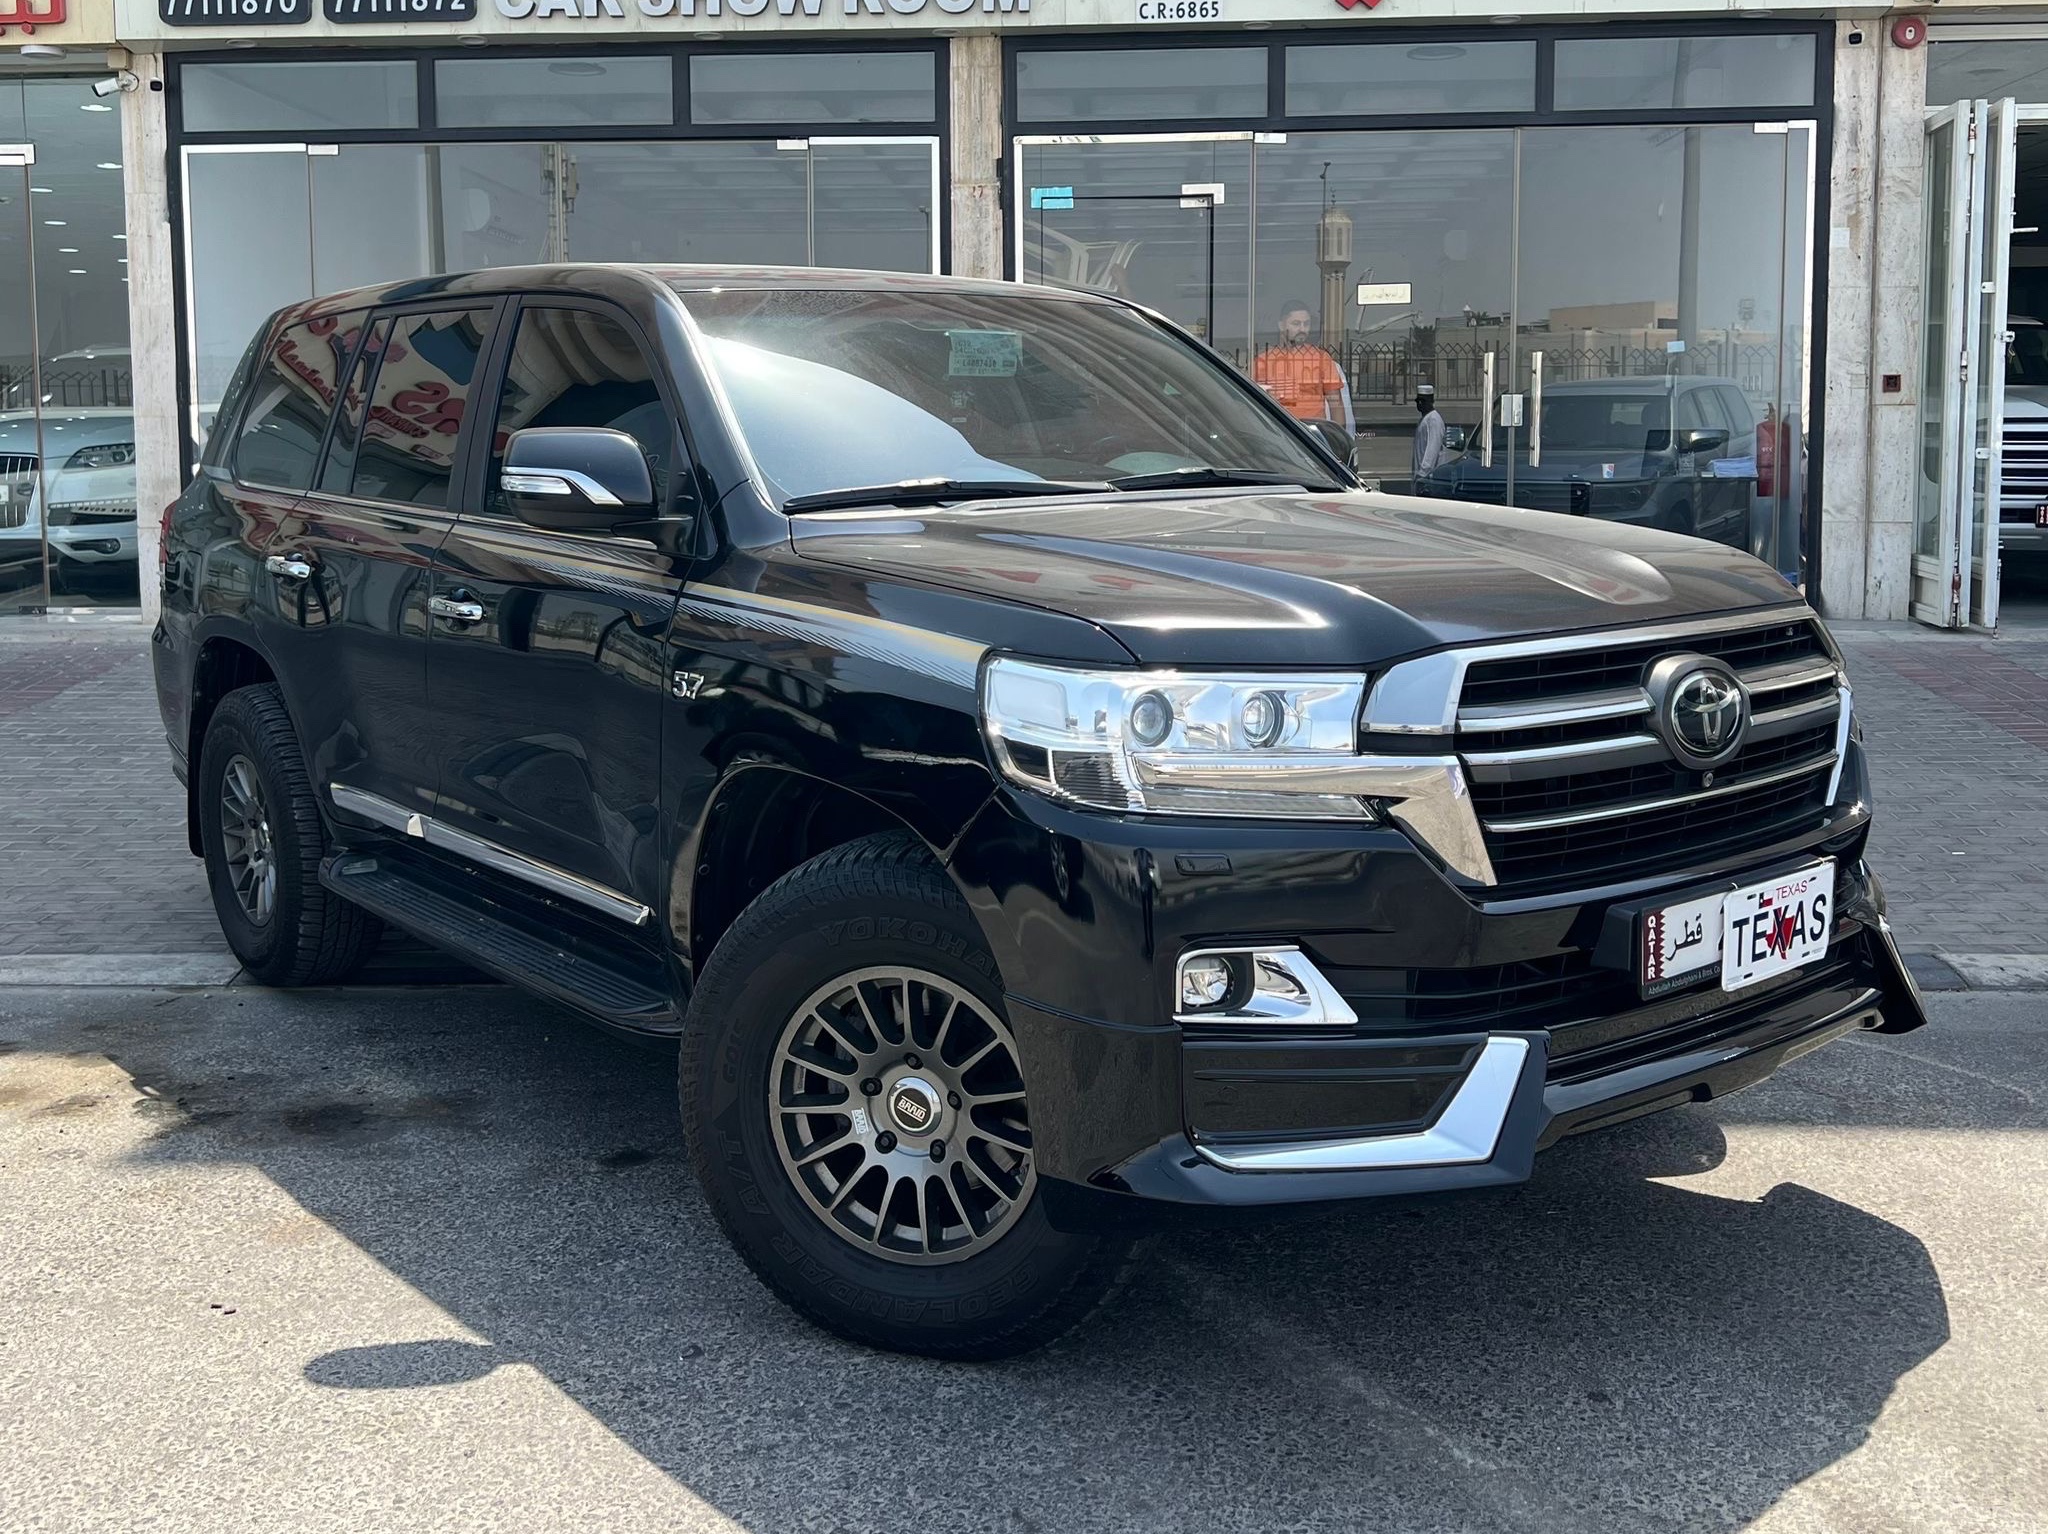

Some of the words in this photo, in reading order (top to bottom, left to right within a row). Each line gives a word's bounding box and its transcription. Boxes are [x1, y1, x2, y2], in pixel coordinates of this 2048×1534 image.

[1139, 1, 1219, 20] C.R:6865
[672, 670, 705, 700] 5.7
[1775, 879, 1808, 900] TEXAS
[1647, 915, 1657, 980] QATAR
[1665, 912, 1703, 962] قطر
[1732, 893, 1827, 968] TEXAS
[820, 916, 1006, 989] YOKOHA
[897, 1097, 926, 1121] BRAID
